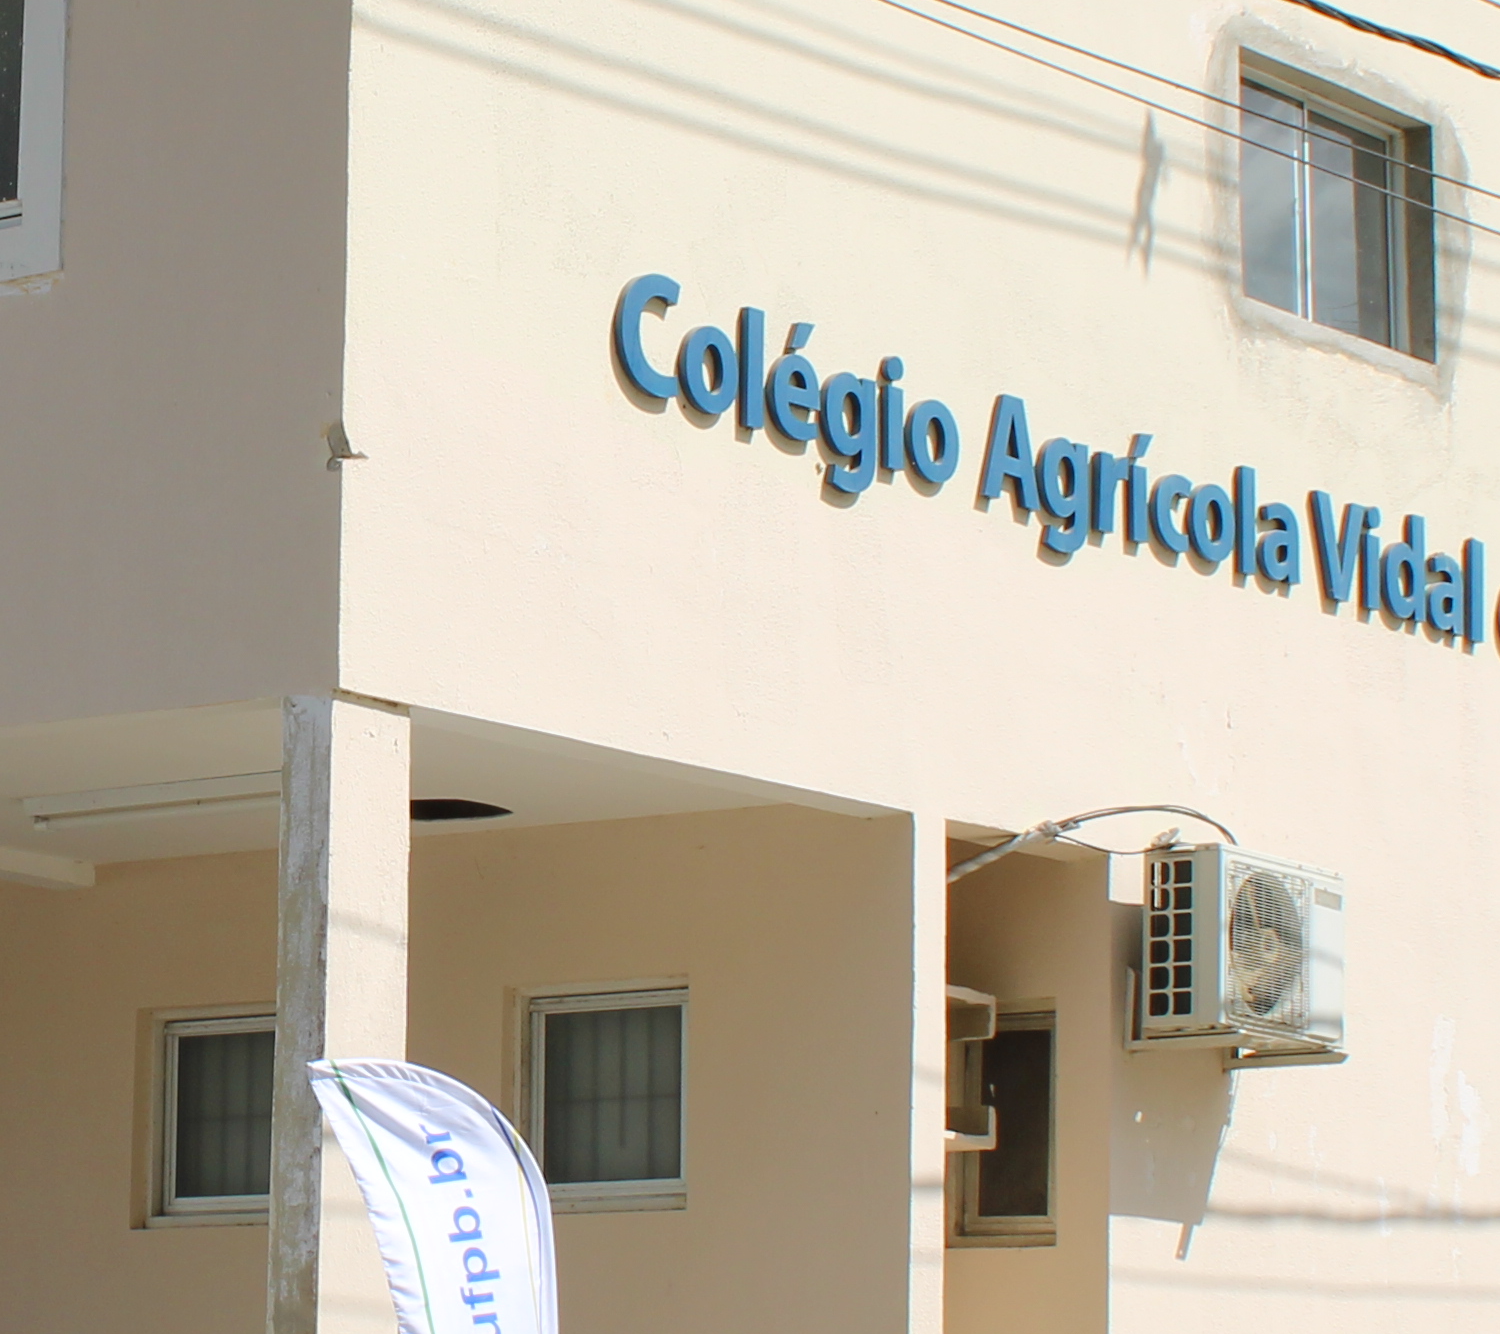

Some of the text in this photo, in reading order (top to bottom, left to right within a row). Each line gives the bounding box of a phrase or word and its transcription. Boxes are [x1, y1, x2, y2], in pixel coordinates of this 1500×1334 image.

[612, 272, 960, 494] Colégio
[979, 393, 1301, 586] Agrícola
[1308, 489, 1485, 644] Vidal
